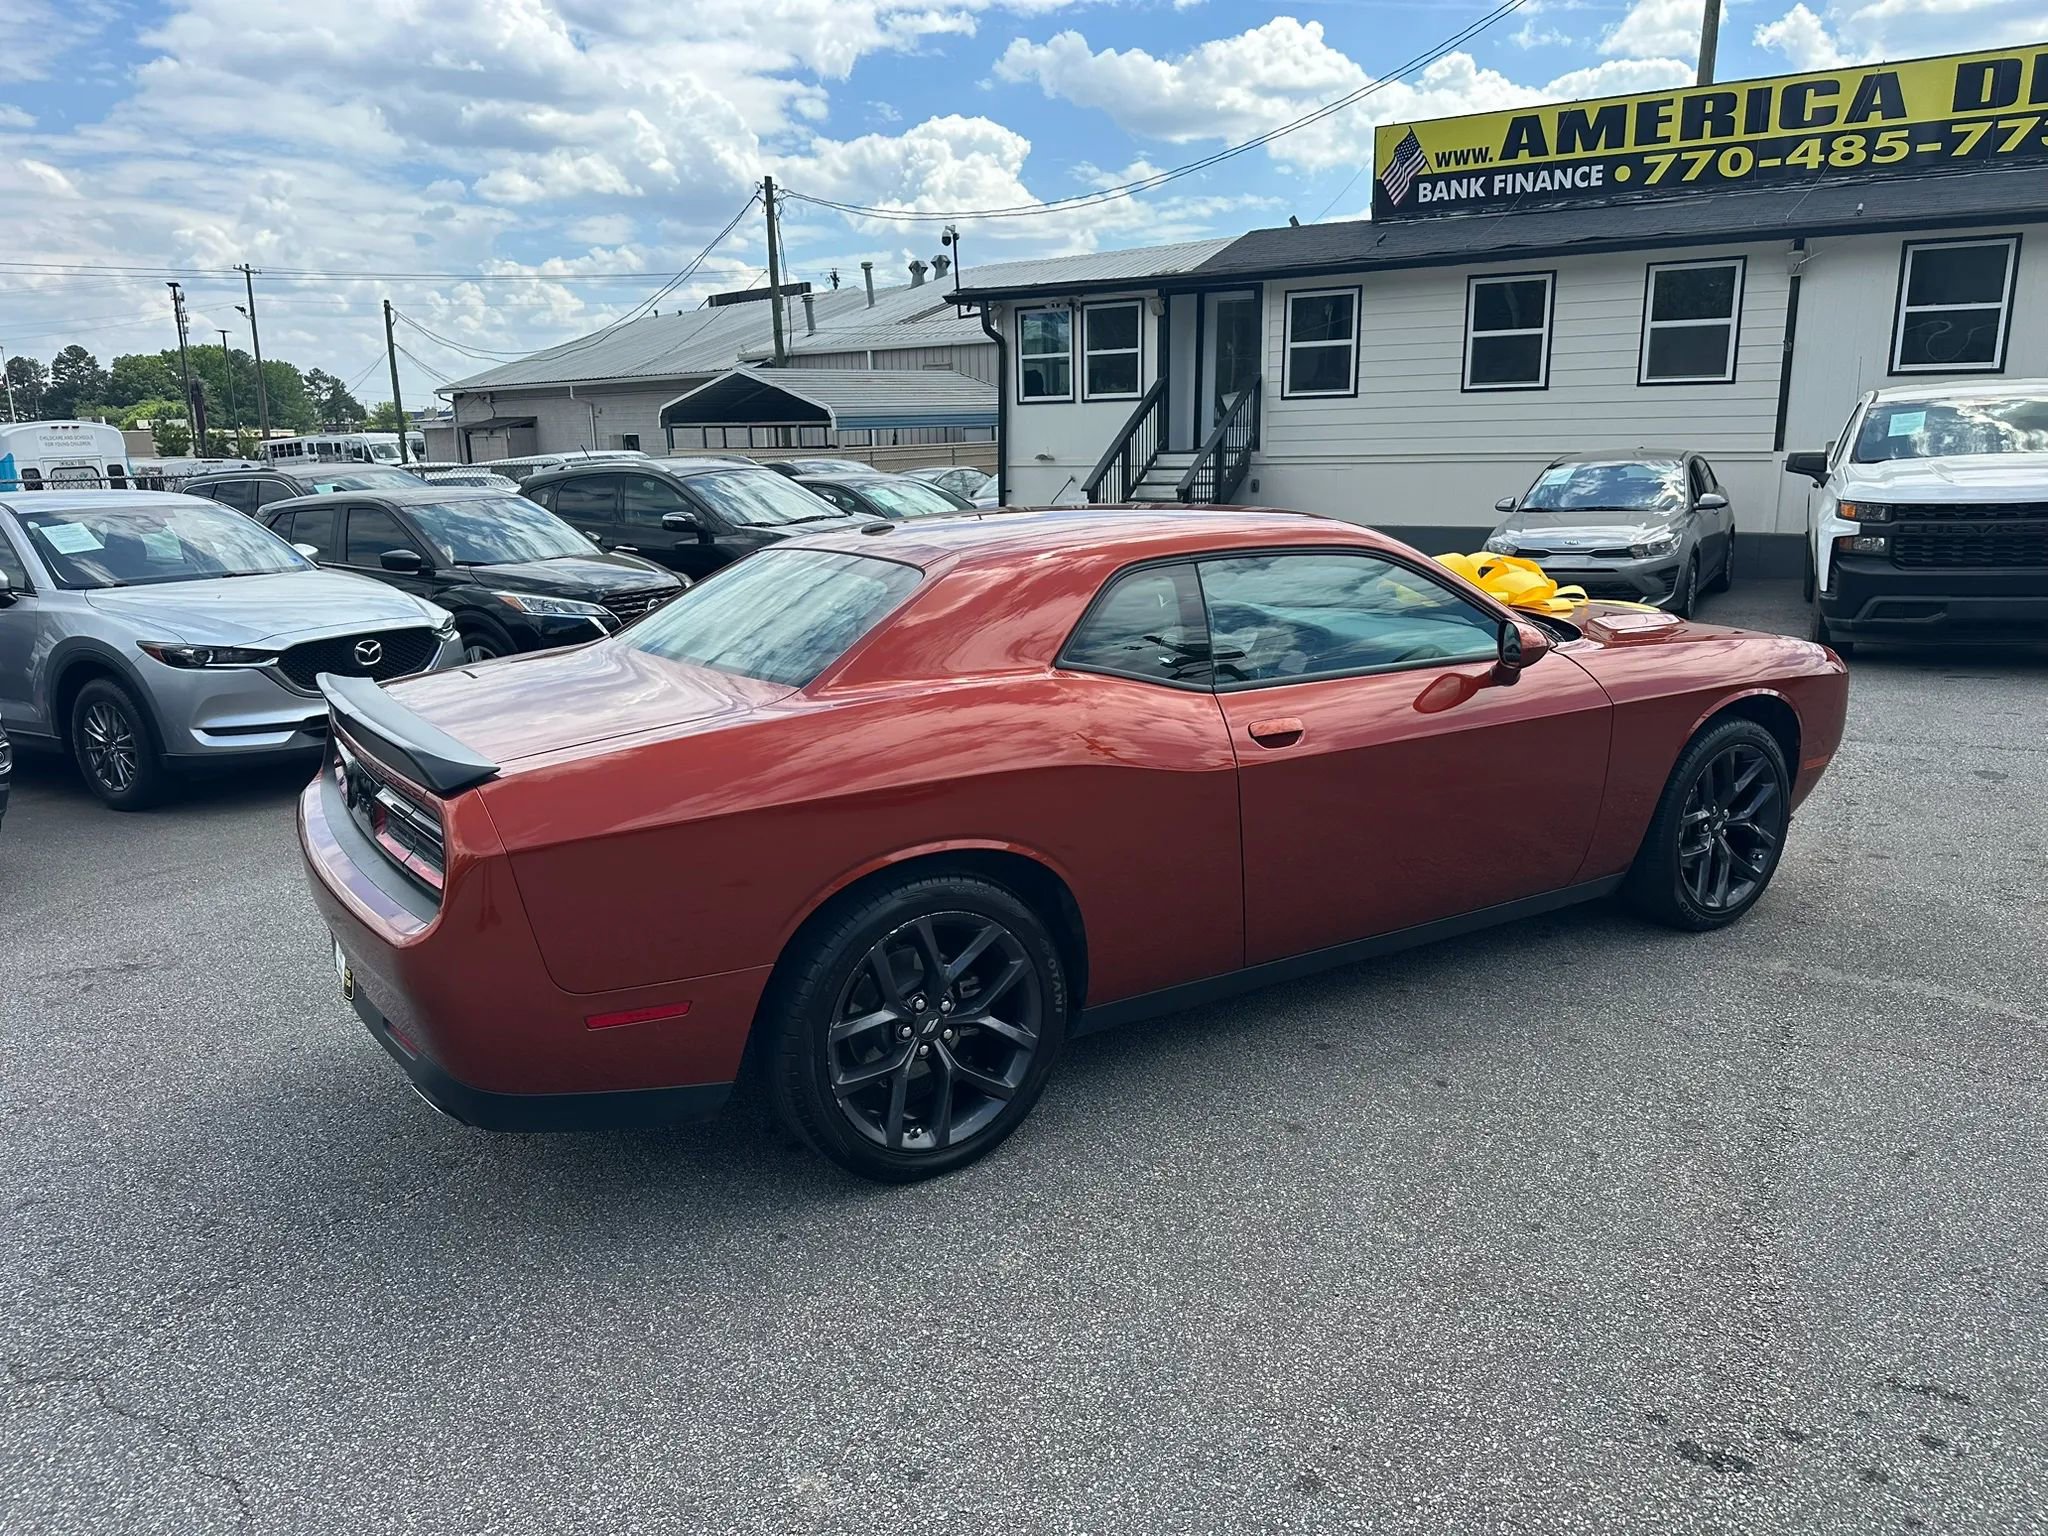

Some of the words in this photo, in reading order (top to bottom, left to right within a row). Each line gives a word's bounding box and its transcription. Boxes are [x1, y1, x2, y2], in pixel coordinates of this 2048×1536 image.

[1418, 176, 1485, 203] BANK
[1493, 164, 1603, 195] FINANCE
[1643, 116, 2048, 185] 770-485-77
[1499, 72, 1907, 161] AMERICA
[1048, 958, 1063, 1012] OTANI
